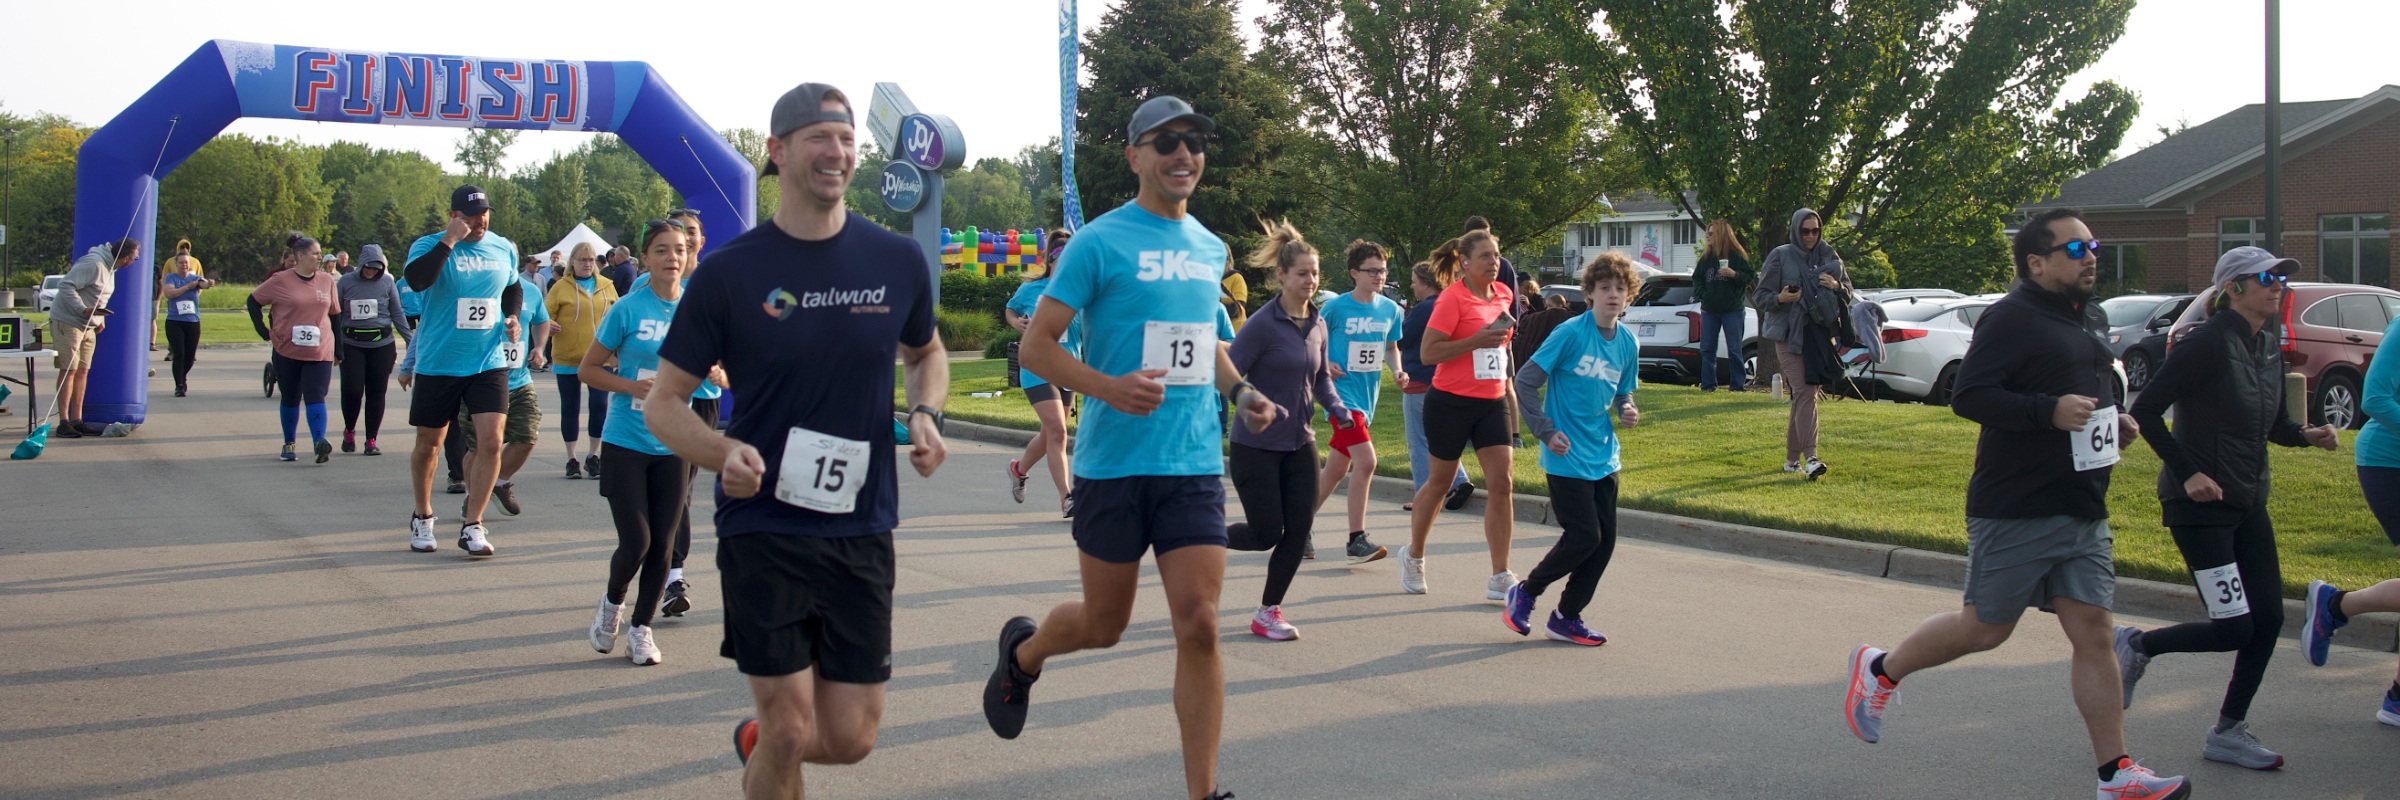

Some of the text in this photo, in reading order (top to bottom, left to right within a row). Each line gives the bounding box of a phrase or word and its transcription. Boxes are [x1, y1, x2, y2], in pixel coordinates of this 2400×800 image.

[294, 50, 578, 123] FINISH
[1136, 250, 1190, 282] 5K
[182, 303, 192, 311] 24
[802, 285, 886, 308] tailwind
[358, 304, 371, 315] 70
[469, 306, 487, 321] 29
[299, 330, 313, 341] 36
[1344, 316, 1373, 335] 5K
[1170, 339, 1194, 369] 13
[1359, 349, 1376, 365] 55
[1573, 354, 1609, 381] 5K
[2091, 422, 2114, 452] 64
[813, 455, 849, 493] 15
[2215, 576, 2243, 605] 39
